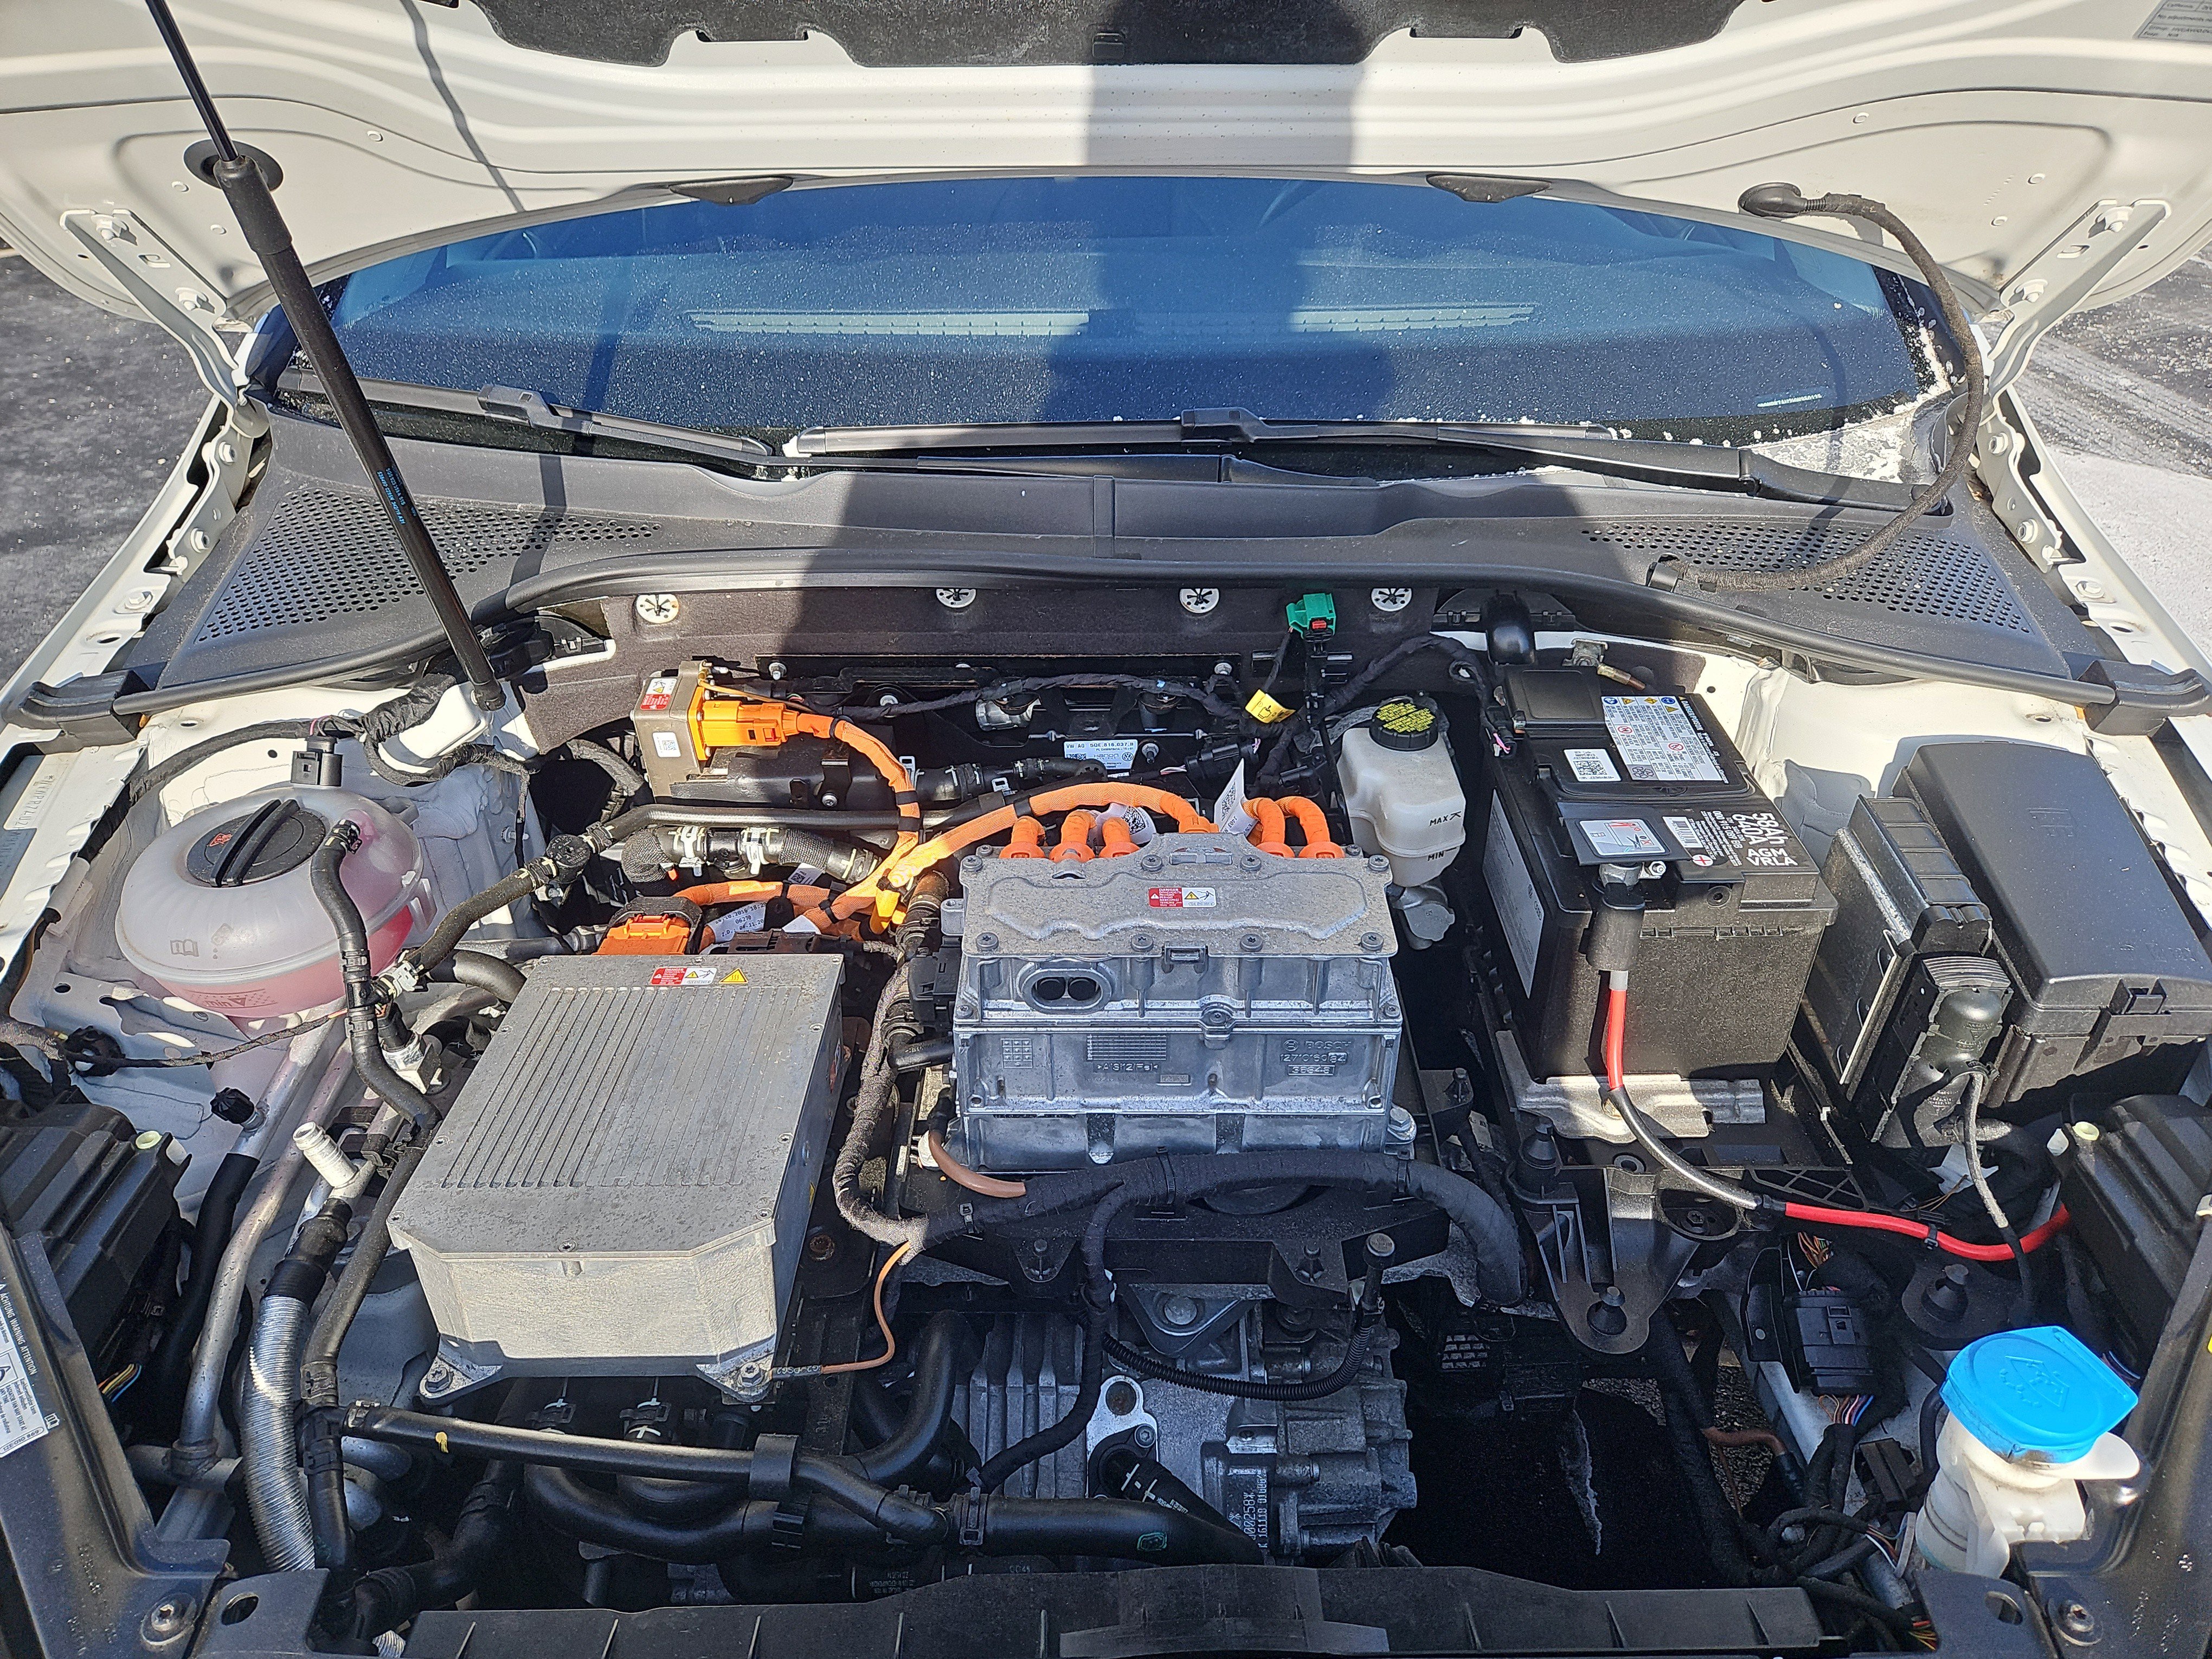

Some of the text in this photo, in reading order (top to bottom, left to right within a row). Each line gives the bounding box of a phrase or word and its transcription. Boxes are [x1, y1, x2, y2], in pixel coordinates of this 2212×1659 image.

[1429, 815, 1449, 826] MAX
[1732, 814, 1768, 845] 640A
[1753, 813, 1789, 844] 58Ah
[1427, 851, 1444, 861] MIN
[1748, 848, 1788, 857] AGM
[1746, 857, 1798, 866] VRLA
[735, 915, 752, 924] 06270
[1, 1292, 37, 1376] ACHTUNG WARNING ATTENTION
